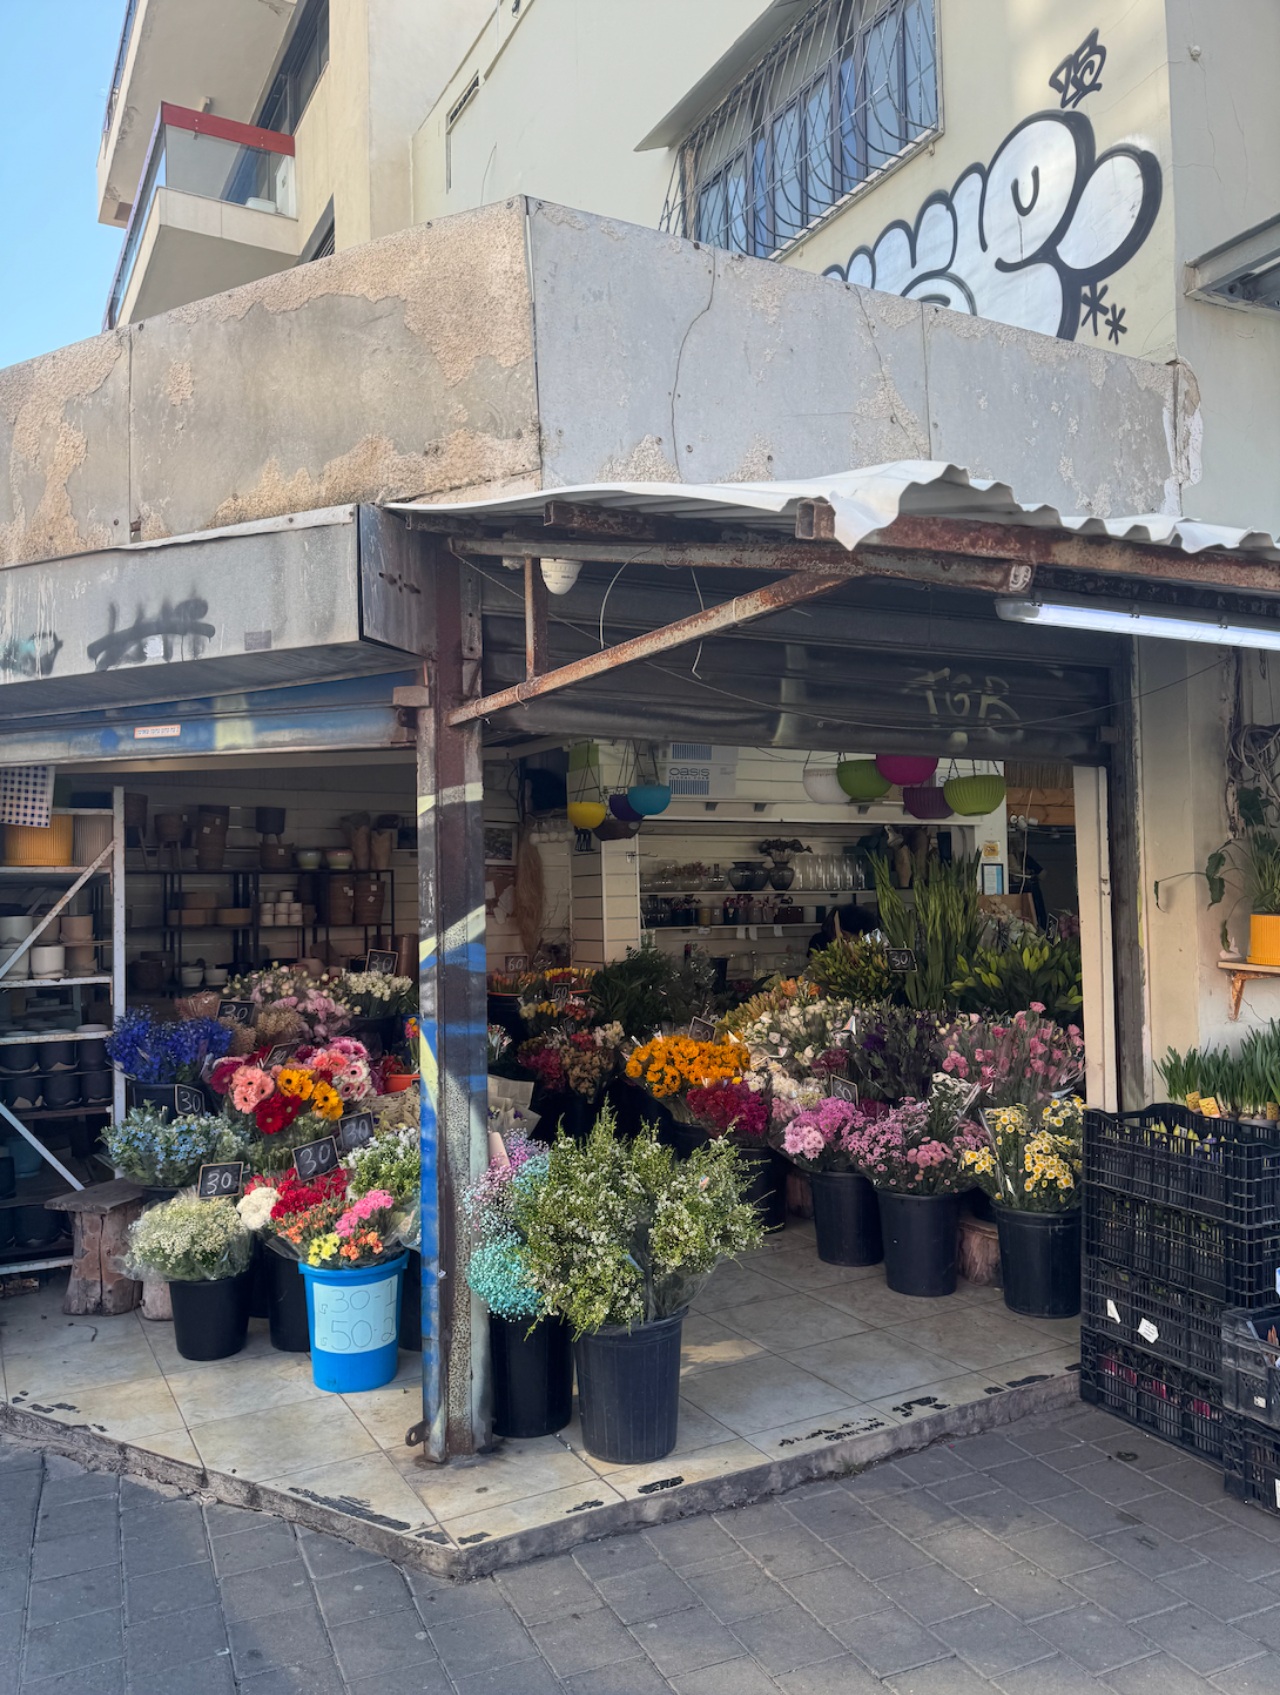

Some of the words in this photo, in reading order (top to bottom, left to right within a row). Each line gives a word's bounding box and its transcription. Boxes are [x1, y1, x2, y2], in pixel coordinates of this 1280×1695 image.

[370, 955, 393, 971] 30
[507, 957, 523, 971] 60
[222, 1004, 248, 1020] 30
[834, 1080, 852, 1101] 30
[180, 1091, 201, 1112] 30
[343, 1119, 369, 1142] 30
[300, 1143, 331, 1175] 30
[207, 1171, 232, 1194] 30
